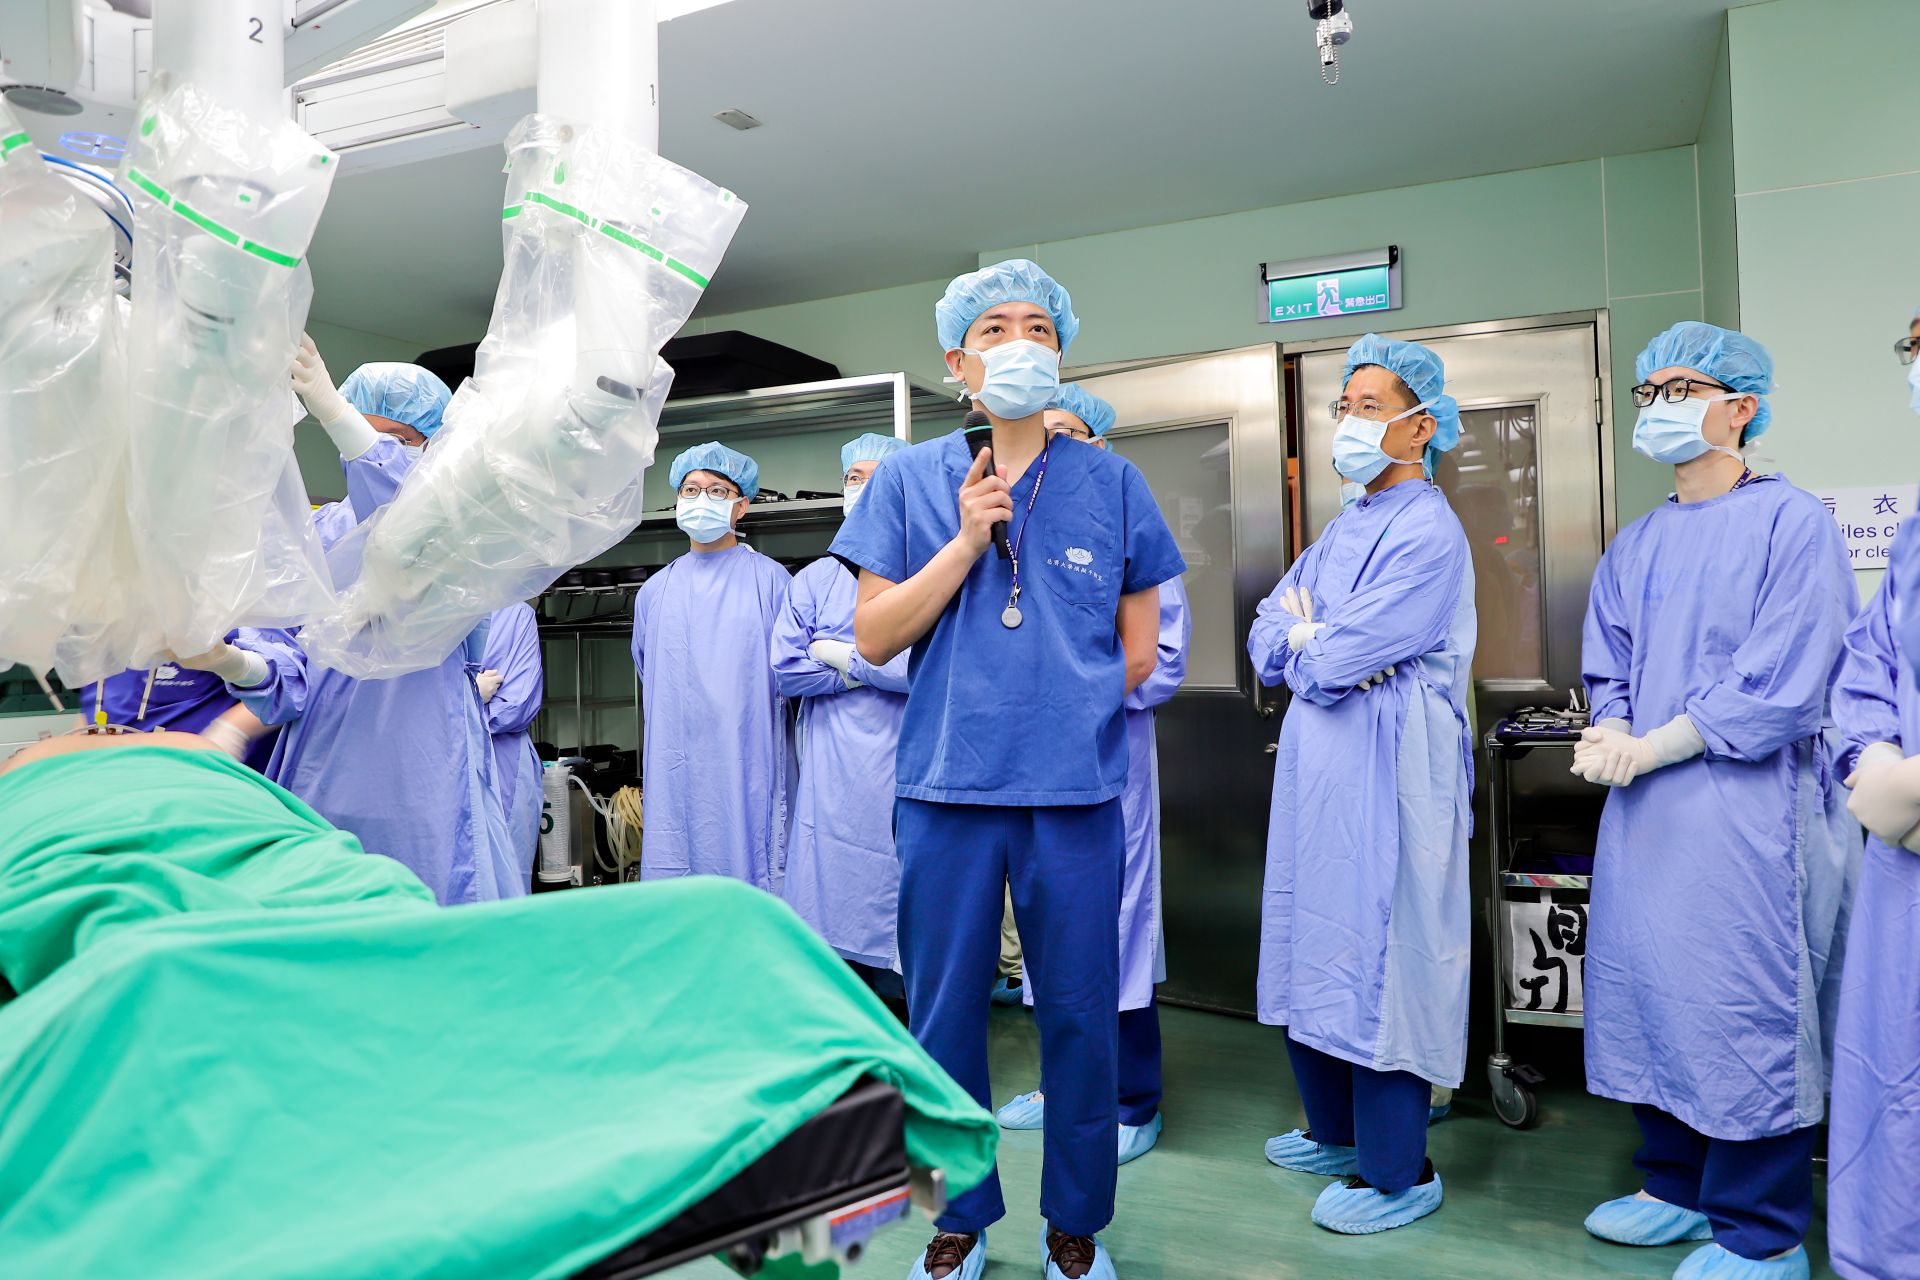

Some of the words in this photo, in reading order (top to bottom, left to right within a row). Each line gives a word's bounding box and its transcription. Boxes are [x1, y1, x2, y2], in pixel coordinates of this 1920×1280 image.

[249, 17, 263, 44] 2
[1345, 294, 1385, 307] 緊急出口
[1275, 303, 1312, 316] EXIT
